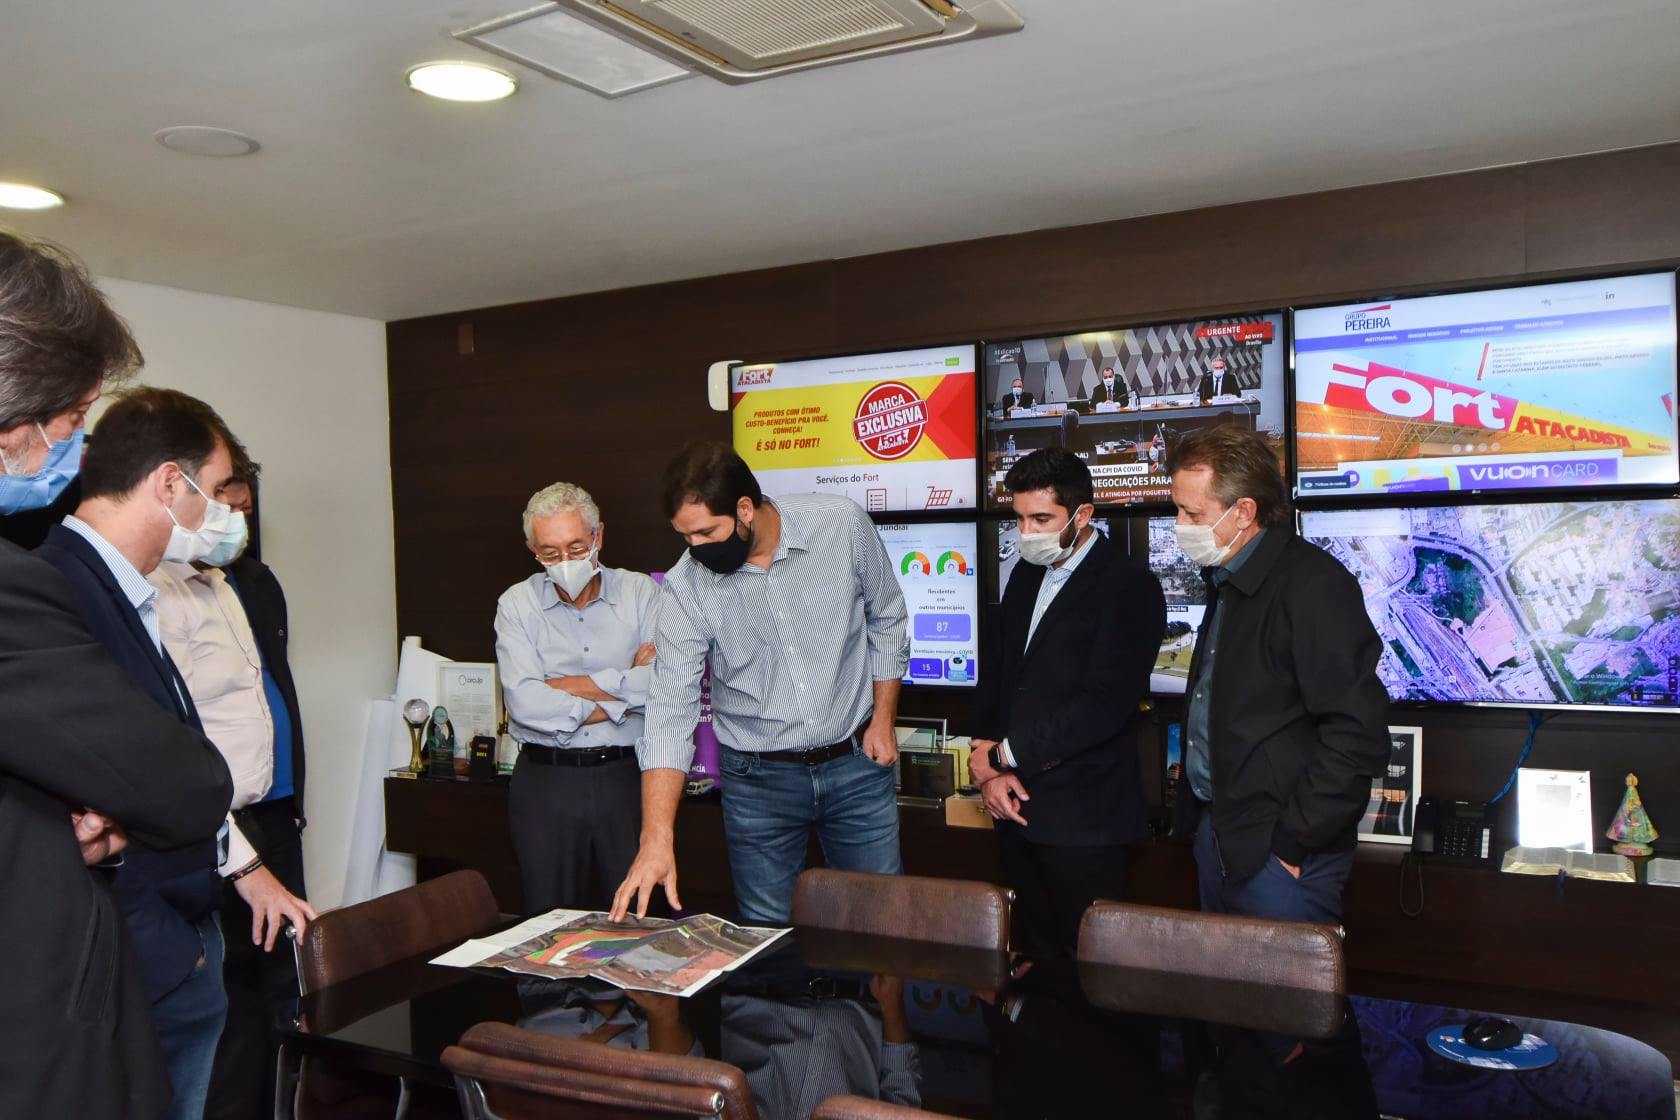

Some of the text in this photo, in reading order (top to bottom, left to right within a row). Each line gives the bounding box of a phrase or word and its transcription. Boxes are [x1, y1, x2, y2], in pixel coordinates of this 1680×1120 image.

[1345, 317, 1391, 331] PEREIRA
[1207, 325, 1241, 336] URGENTE
[737, 378, 771, 386] ATACADISTA
[1308, 358, 1505, 430] Fort
[868, 393, 906, 414] MARCA
[753, 406, 821, 418] PRODUTOS COM ÓTIMO
[798, 416, 811, 424] PRA
[857, 405, 924, 437] EXCLUSIVA
[772, 427, 803, 436] CONHEÇA!
[880, 431, 907, 444] Fort
[1516, 415, 1633, 449] ATACADISTA
[756, 438, 820, 451] É SÓ NO FORT!
[1123, 465, 1143, 473] COVID
[816, 473, 879, 485] Serviços do Fort
[1092, 476, 1173, 488] NEGOCIAÇÕES PARA
[936, 622, 948, 632] 87
[922, 663, 931, 671] 15
